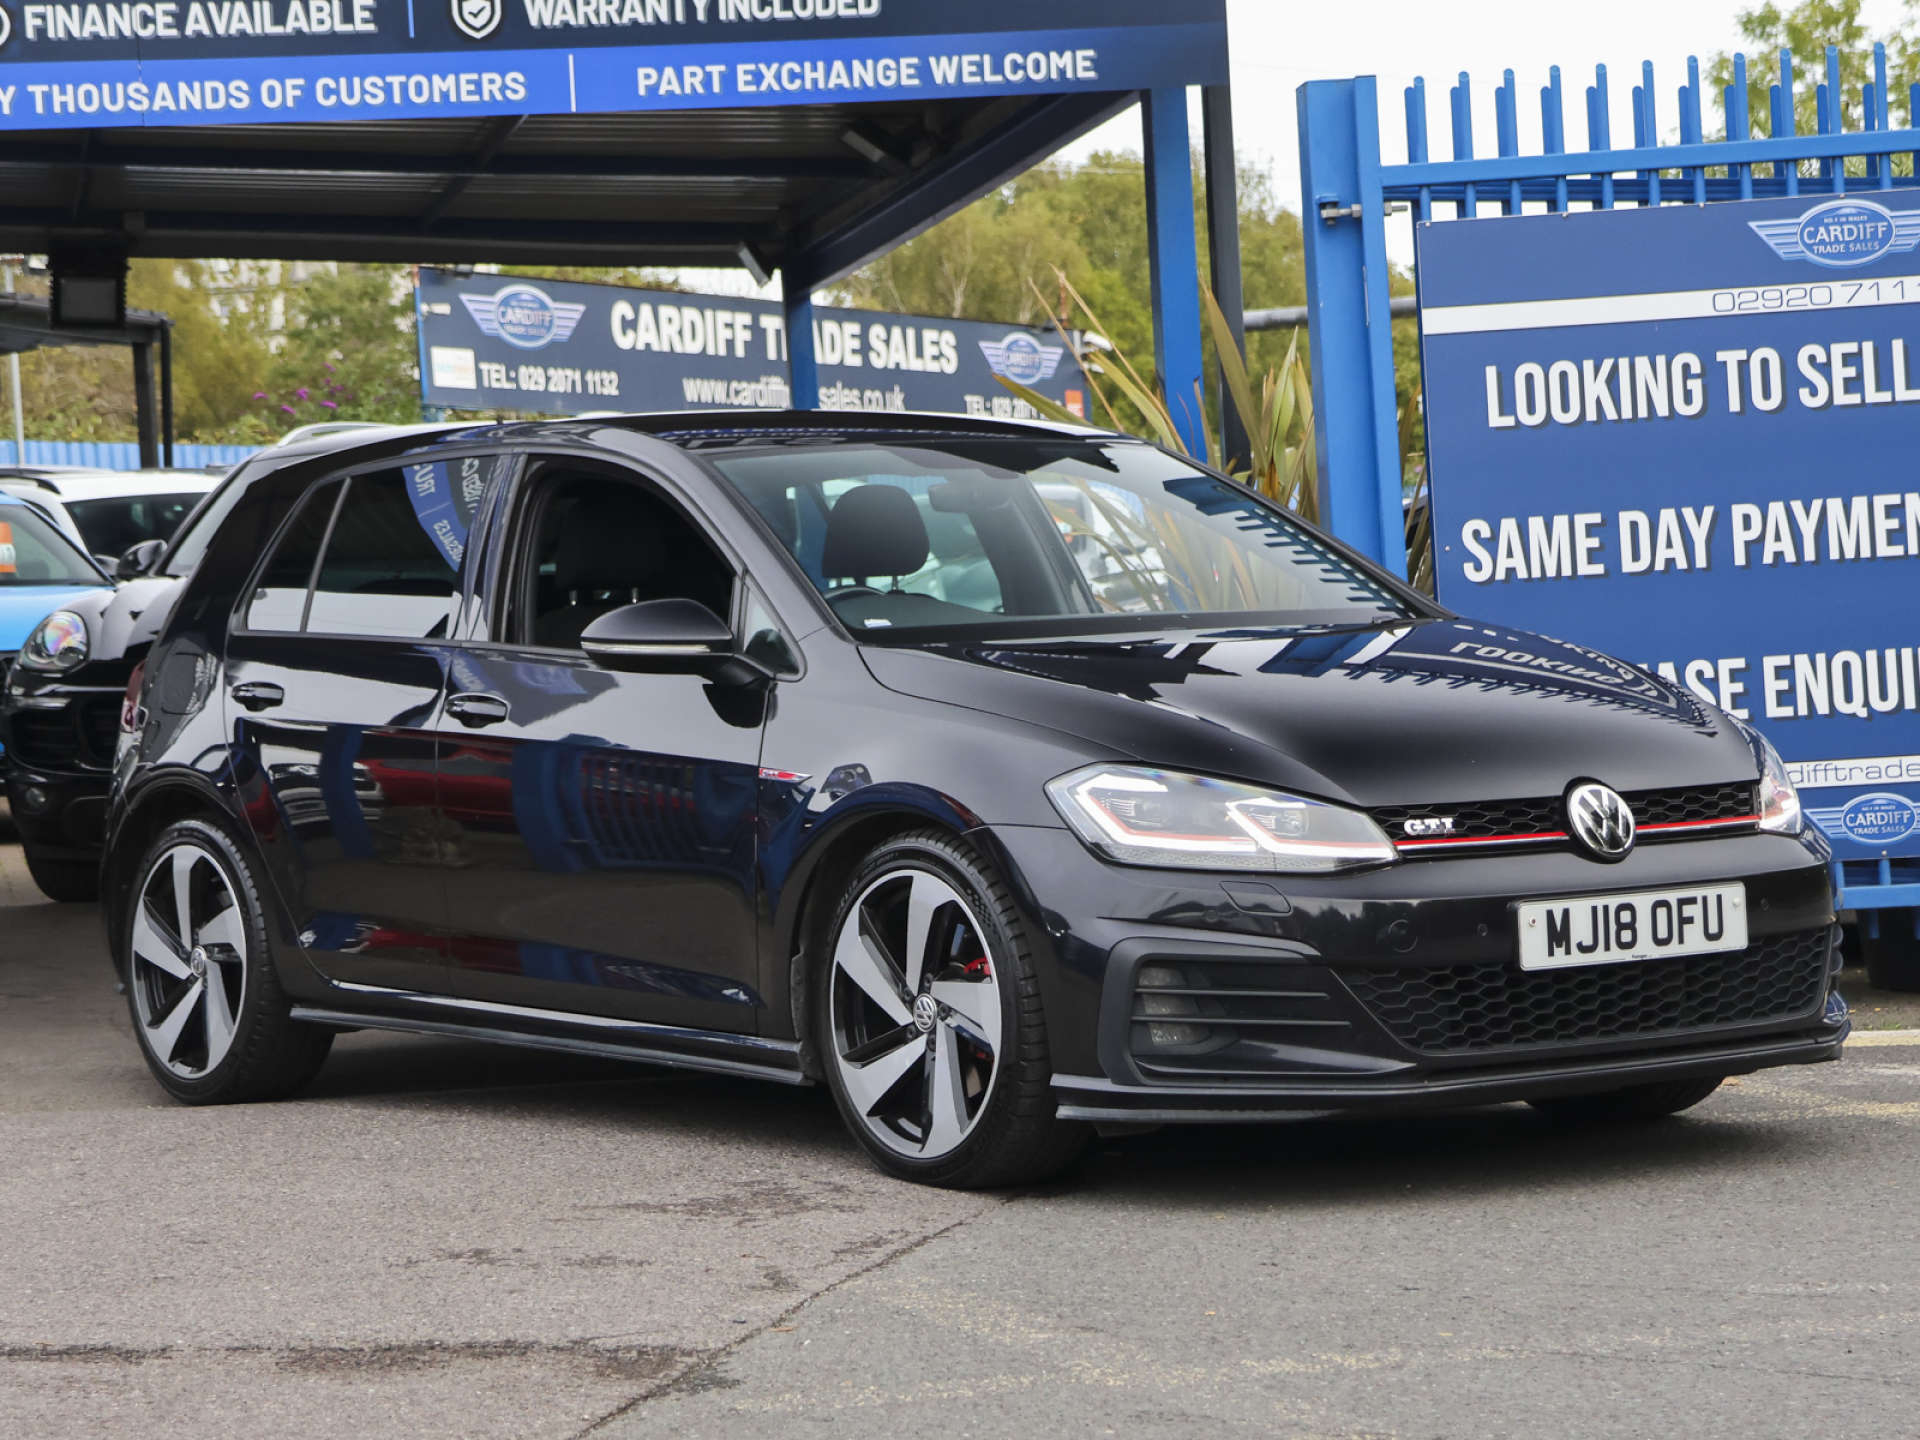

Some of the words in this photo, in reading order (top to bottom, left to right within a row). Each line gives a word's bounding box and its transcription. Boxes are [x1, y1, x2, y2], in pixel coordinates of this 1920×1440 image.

[24, 3, 181, 40] FINANCE
[184, 0, 379, 38] AVAILABLE
[525, 0, 710, 29] WARRANTY
[636, 65, 727, 97] PART
[736, 56, 921, 92] EXCHANGE
[929, 48, 1098, 84] WELCOME
[28, 80, 254, 115] THOUSANDS
[260, 77, 306, 108] OF
[315, 71, 528, 106] CUSTOMERS
[1803, 222, 1889, 244] CARDIFF
[1813, 243, 1847, 255] TRADE
[1849, 241, 1880, 253] SALES
[1712, 285, 1832, 314] 02920
[1841, 280, 1920, 304] 711
[611, 299, 753, 359] CARDIFF
[758, 314, 864, 368] TDE
[868, 322, 959, 375] SALES
[478, 362, 517, 390] TEL:
[518, 364, 547, 392] 029
[547, 366, 583, 394] 2071
[585, 369, 620, 397] 1132
[1485, 352, 1703, 428] LOOKING
[1716, 346, 1784, 413] TO
[1797, 338, 1920, 409] SELL
[1461, 512, 1605, 584] SAME
[1619, 505, 1715, 574] DAY
[1762, 647, 1920, 718] ENQUI
[1404, 817, 1457, 837] GTI
[1845, 810, 1911, 827] CARDIFF
[1546, 901, 1638, 958] MJ18
[1650, 892, 1725, 948] OFU
